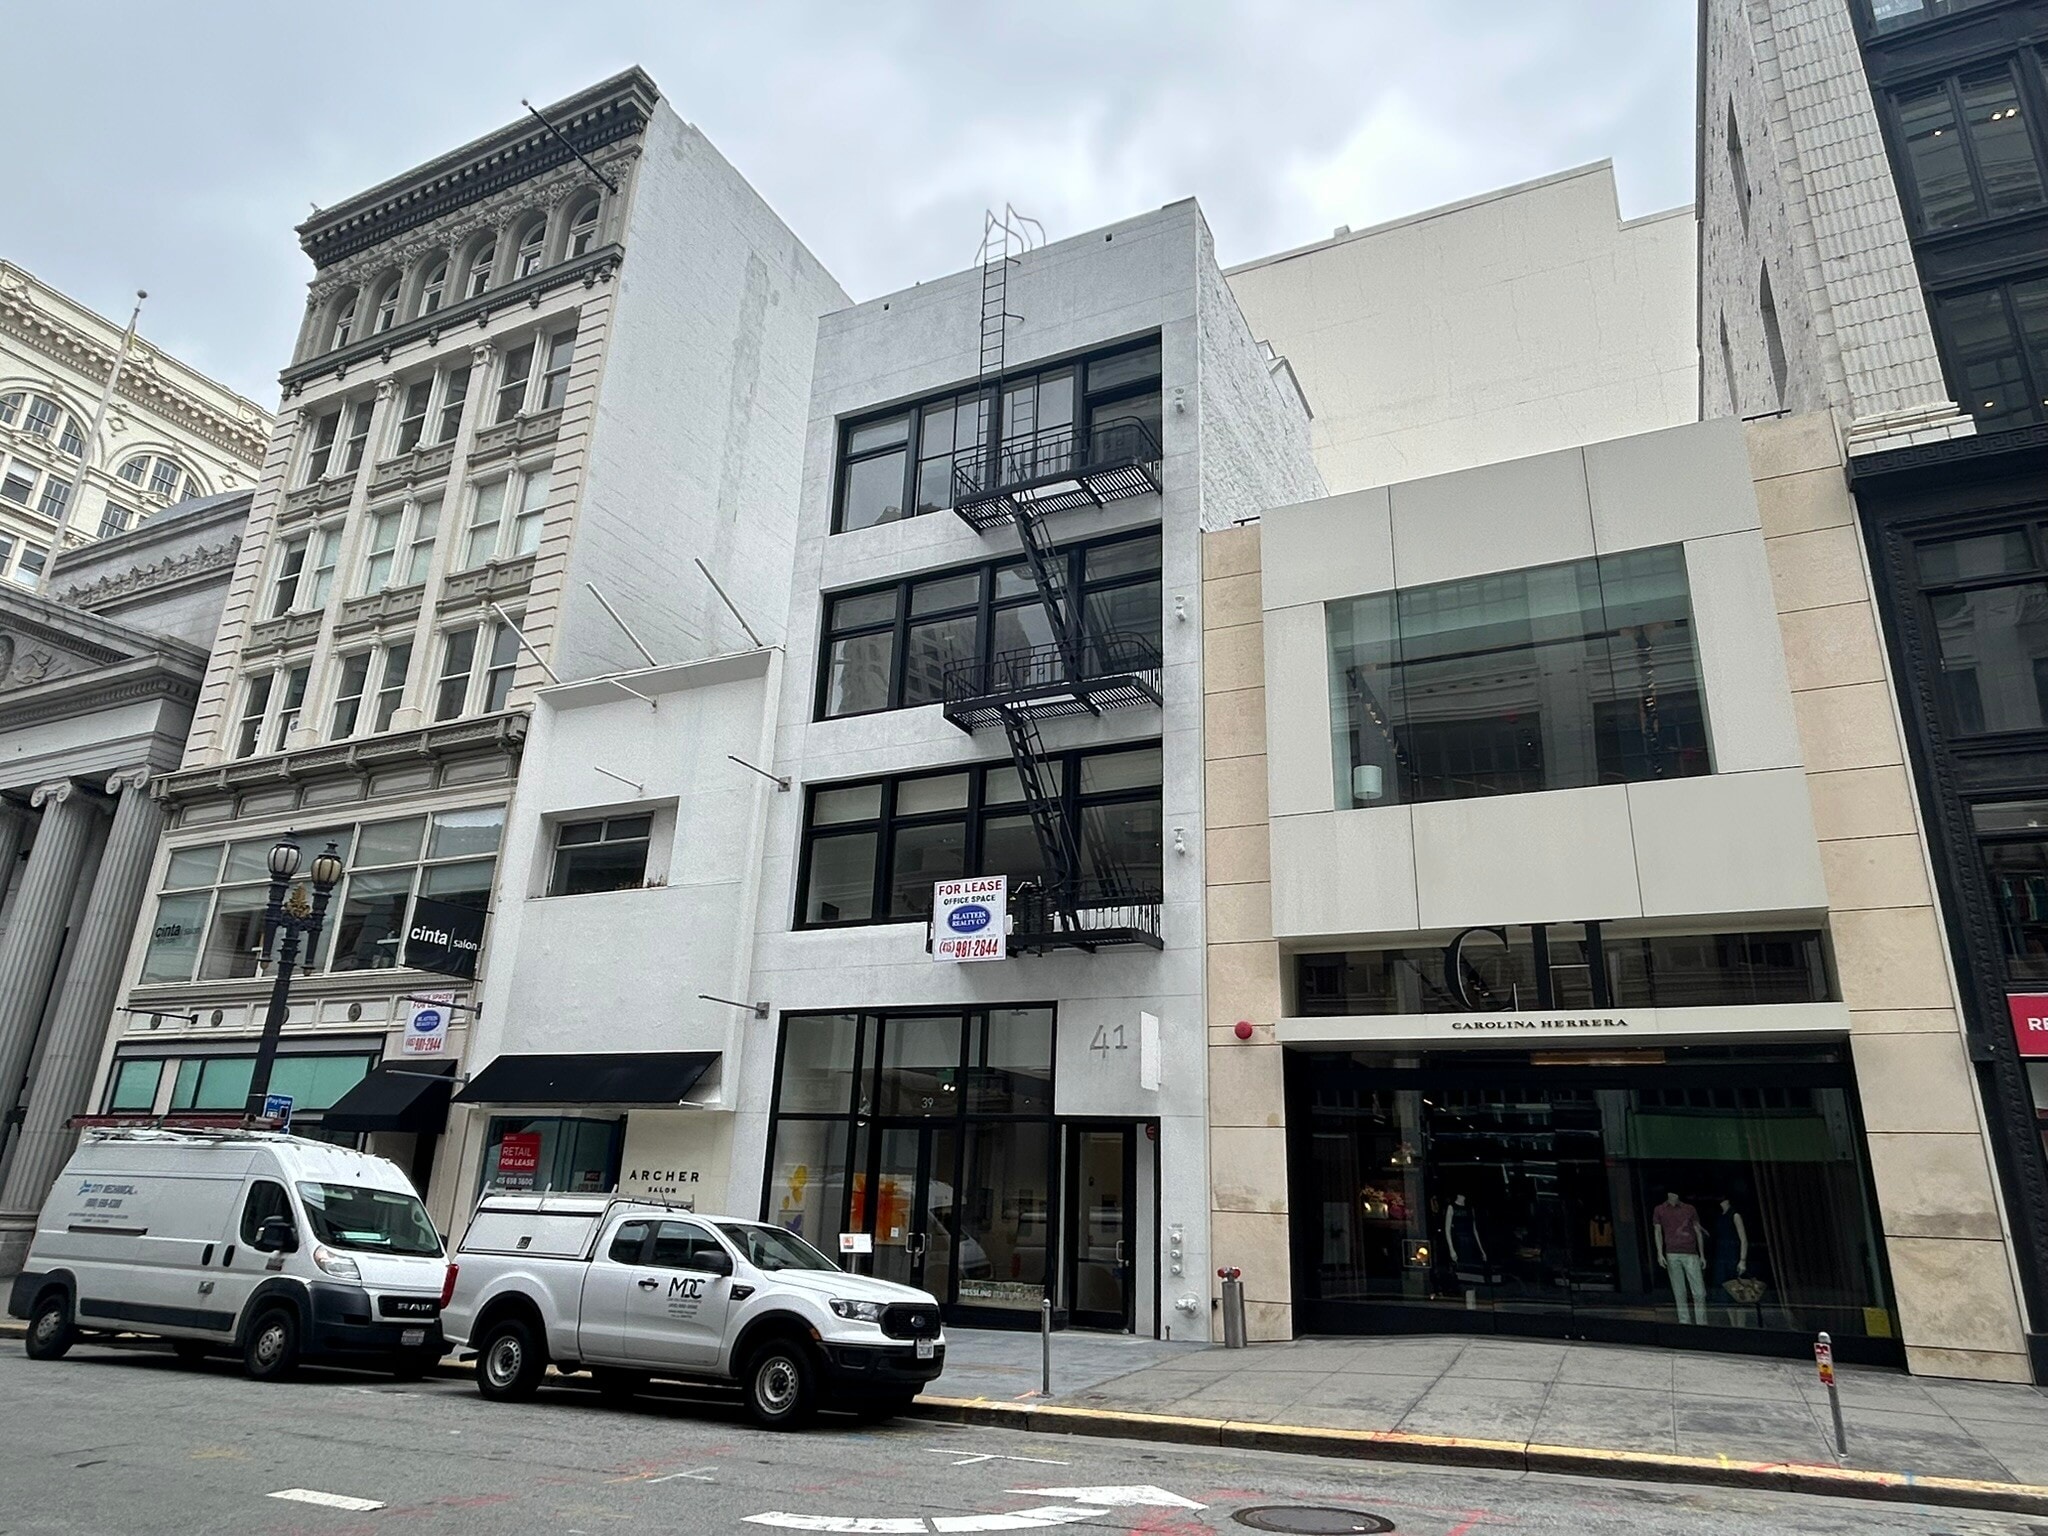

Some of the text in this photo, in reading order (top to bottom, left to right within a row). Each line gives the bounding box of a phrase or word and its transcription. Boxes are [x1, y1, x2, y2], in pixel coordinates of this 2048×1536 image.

[938, 880, 1002, 895] FOR LEASE
[943, 894, 996, 905] OFFICE SPACE
[156, 923, 181, 938] cinta
[410, 926, 478, 951] cinta salon
[955, 939, 999, 958] 981-2844
[1452, 1018, 1628, 1030] CAROLINA HERRERA
[1089, 1024, 1128, 1058] 41
[921, 1097, 934, 1109] 39
[502, 1146, 532, 1156] RETAIL
[500, 1158, 535, 1167] FOR LEASE
[629, 1169, 700, 1182] ARCHER
[647, 1186, 677, 1194] SALON
[397, 1303, 433, 1311] RAM
